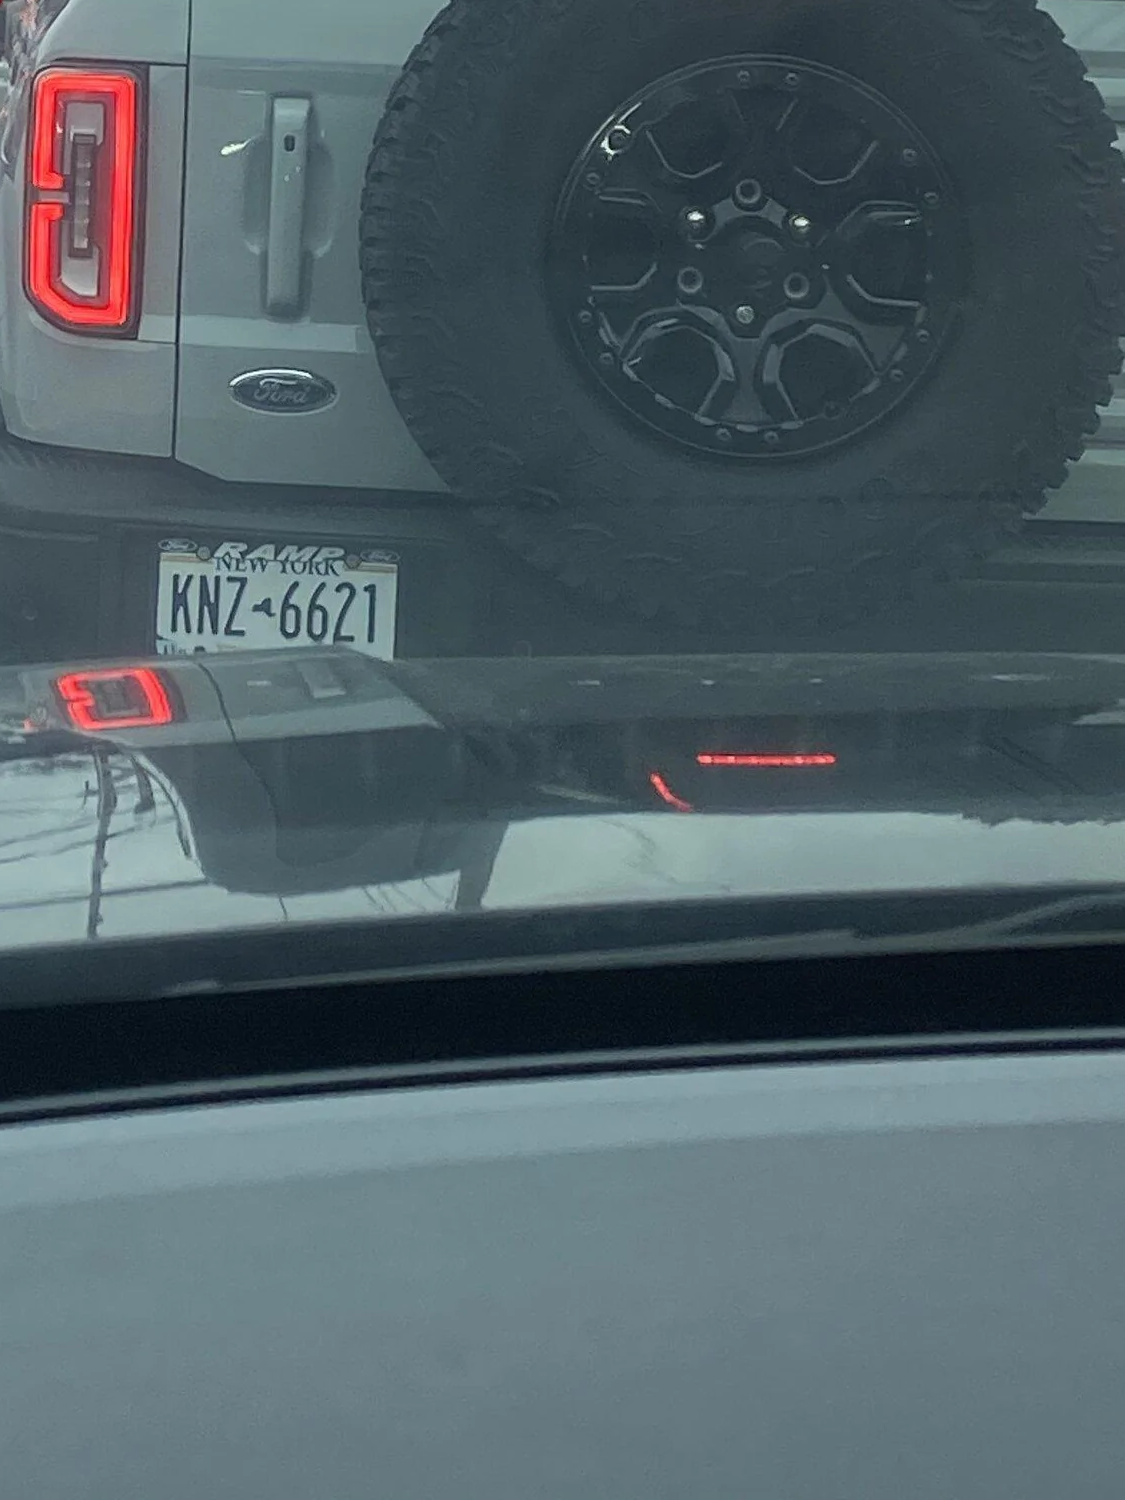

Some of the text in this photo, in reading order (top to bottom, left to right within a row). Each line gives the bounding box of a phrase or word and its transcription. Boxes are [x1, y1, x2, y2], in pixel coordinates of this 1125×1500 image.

[253, 377, 312, 404] Ford
[213, 541, 345, 562] RAMP
[215, 556, 340, 577] NEW YORK
[170, 573, 377, 644] KNZ 6621
